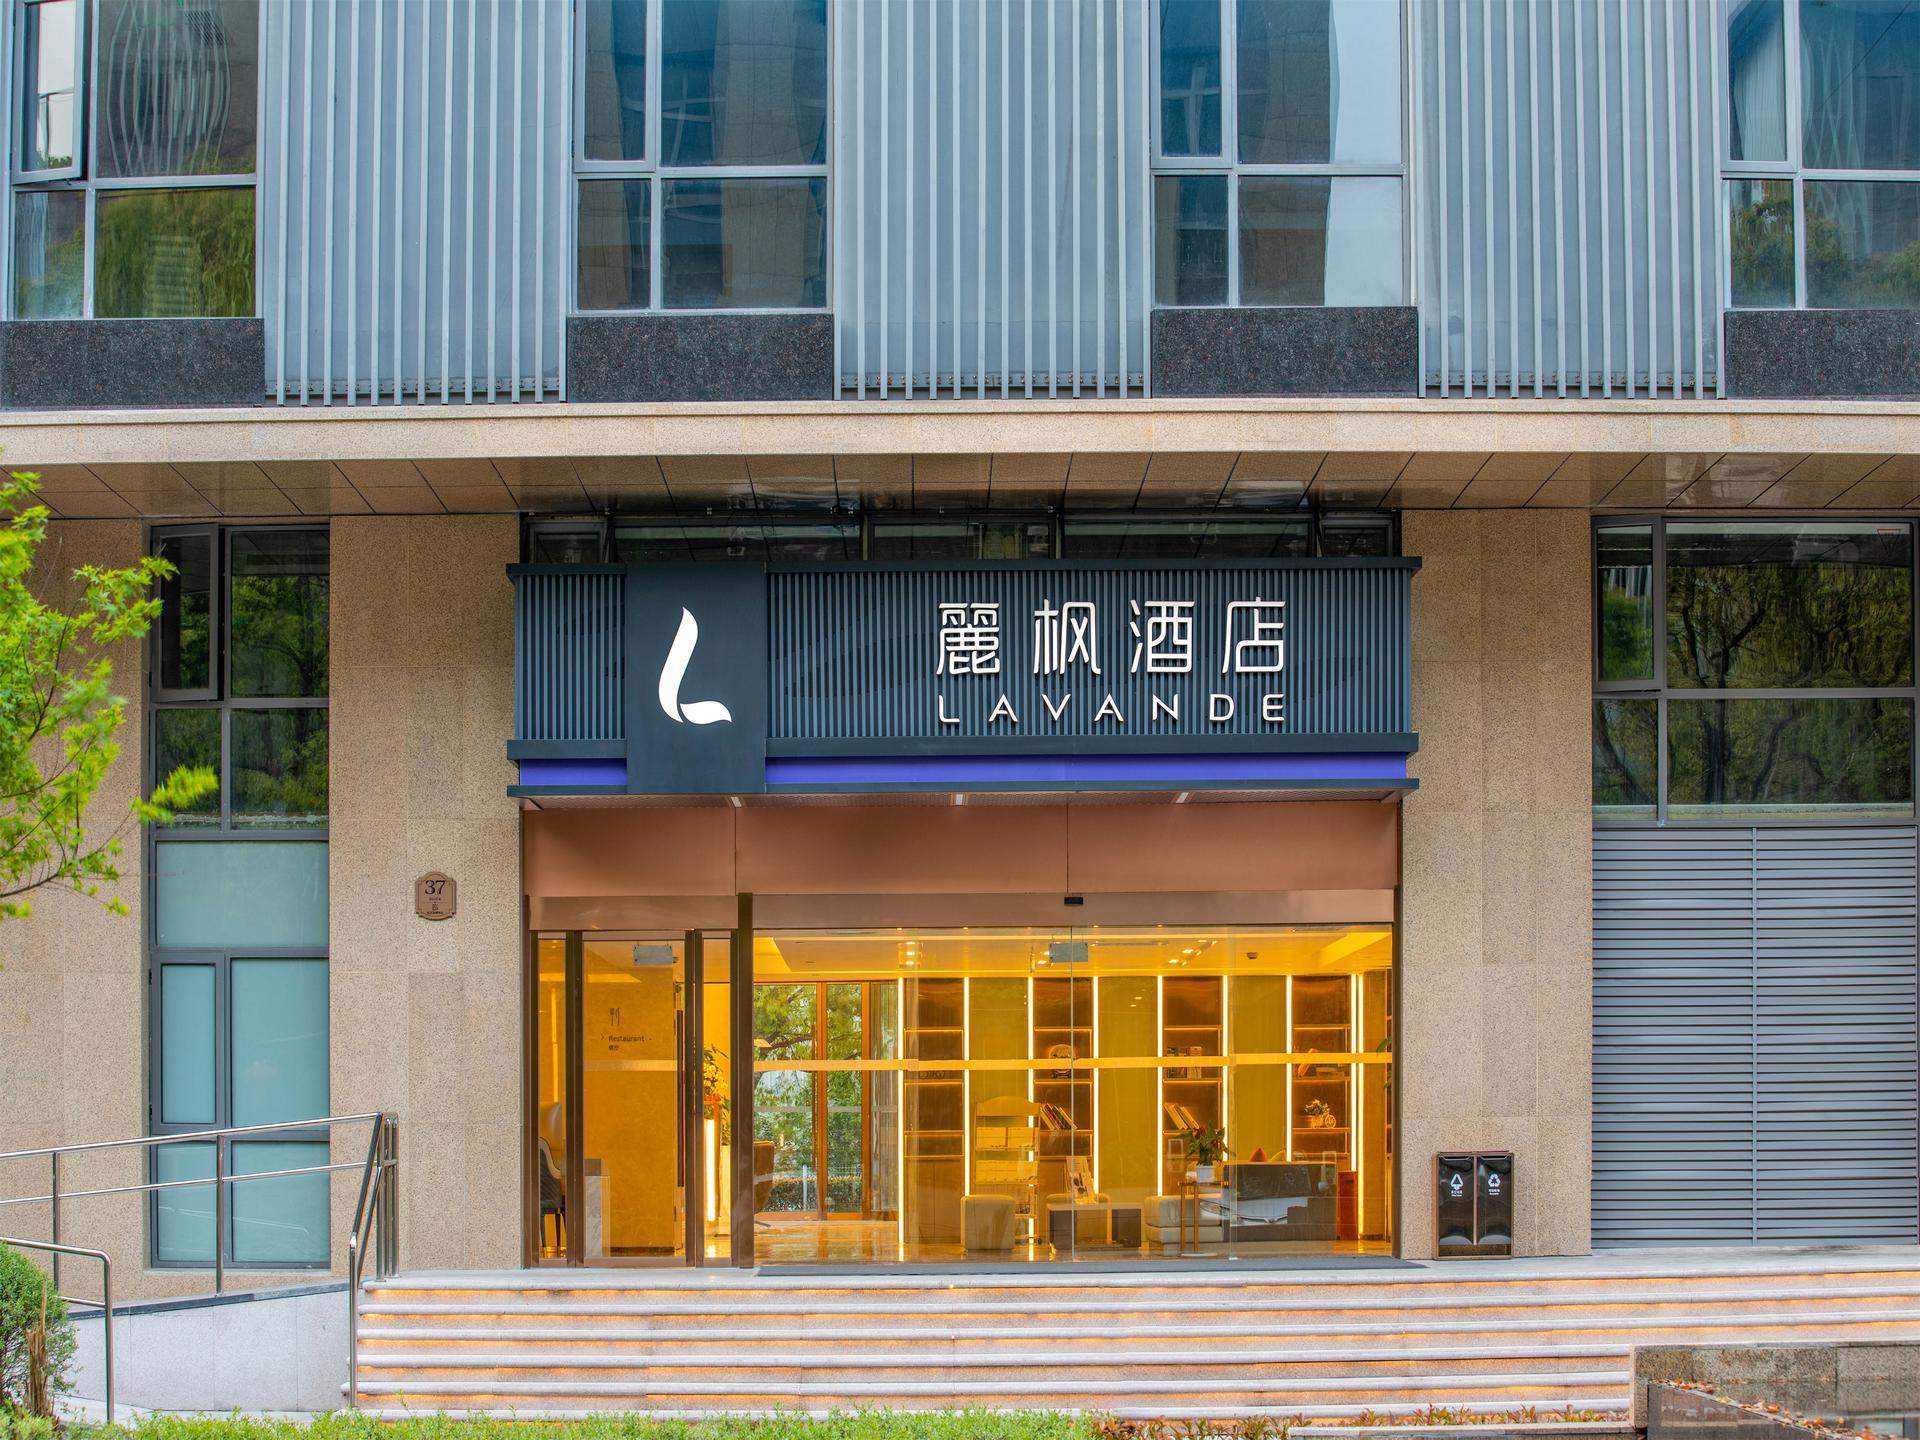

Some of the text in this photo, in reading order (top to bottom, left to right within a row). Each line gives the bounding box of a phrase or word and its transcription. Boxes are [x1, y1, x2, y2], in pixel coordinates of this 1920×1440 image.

[936, 597, 1286, 674] 麗枫酒店
[938, 693, 1285, 723] LAVANDE
[424, 879, 446, 895] 37
